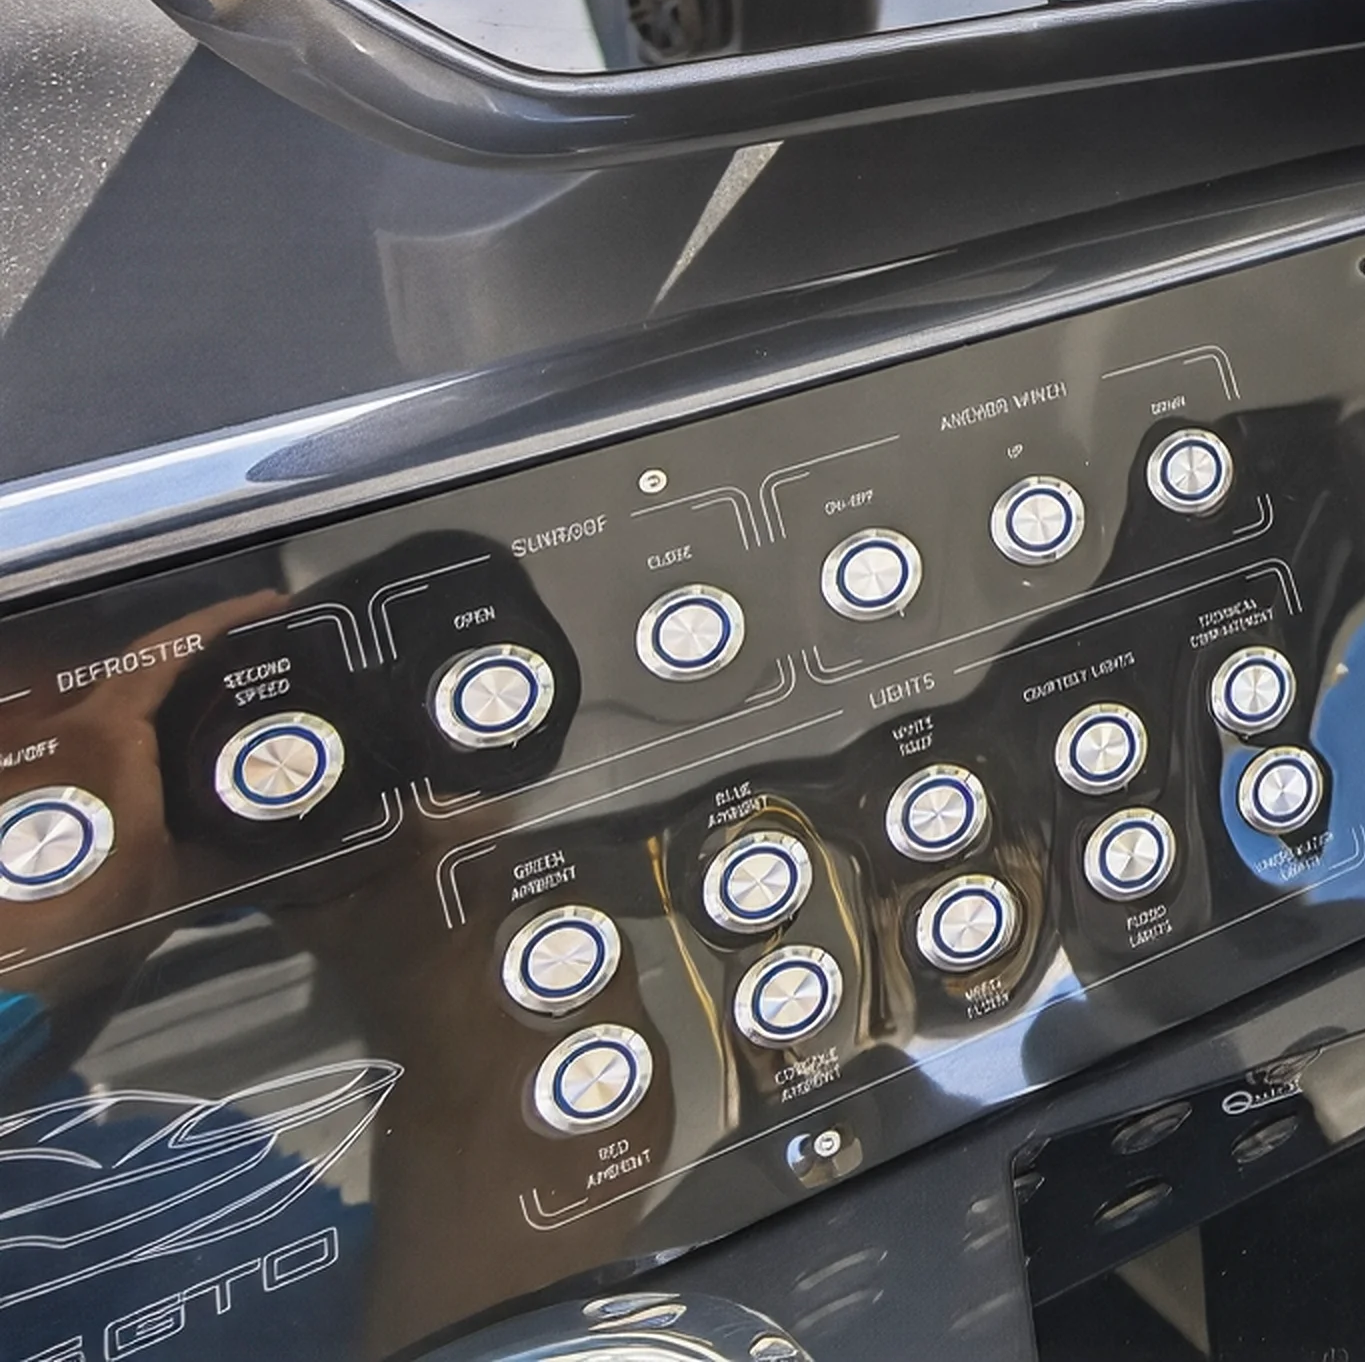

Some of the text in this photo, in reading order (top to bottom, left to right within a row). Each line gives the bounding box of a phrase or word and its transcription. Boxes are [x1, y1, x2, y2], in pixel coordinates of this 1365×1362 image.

[56, 632, 206, 694] DEFROSTER
[222, 656, 293, 690] SECOND
[234, 677, 292, 707] SPEED
[868, 671, 937, 711] LIGHTS
[103, 1225, 339, 1362] GTO
